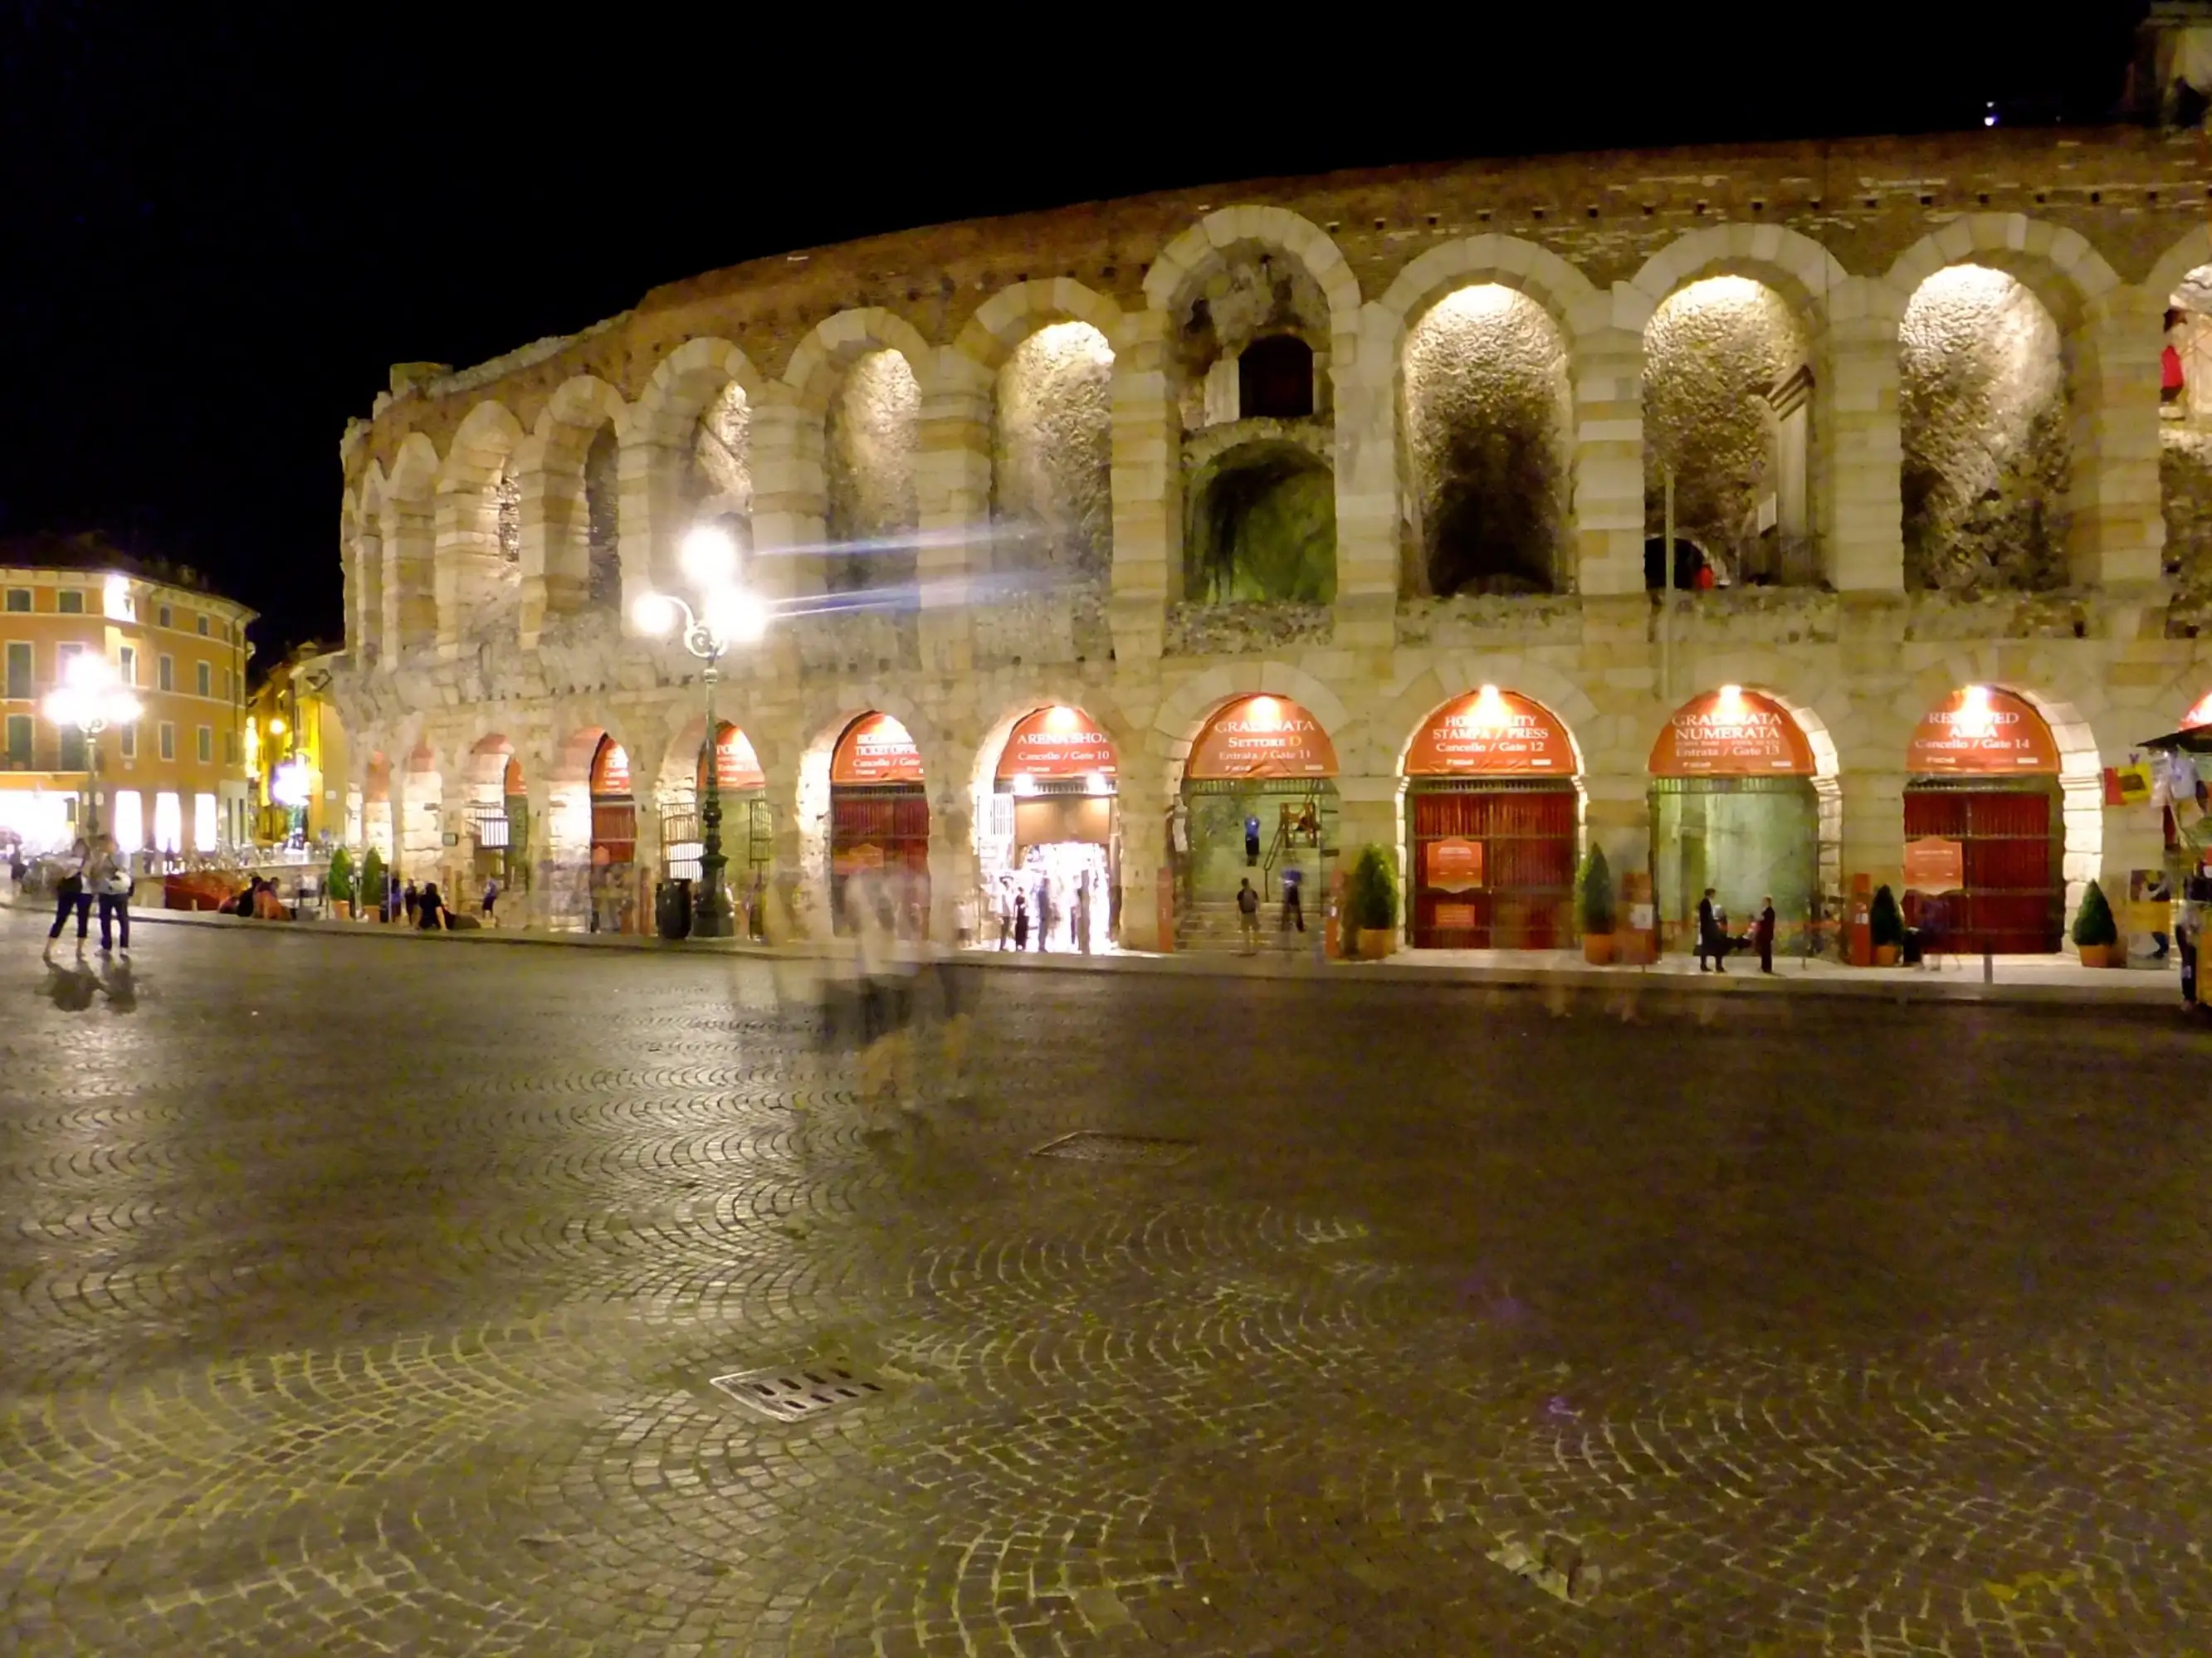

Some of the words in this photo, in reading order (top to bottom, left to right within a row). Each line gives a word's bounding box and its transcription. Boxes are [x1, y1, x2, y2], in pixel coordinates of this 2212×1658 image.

[1445, 715, 1537, 728] HOLITY
[1929, 712, 2020, 724] REVED
[1433, 728, 1491, 740] STAMPA
[1507, 728, 1549, 739] PRESS
[1675, 726, 1780, 739] NUMERATA
[1948, 724, 1999, 738] AA
[1017, 733, 1069, 745] ARENA
[1228, 737, 1287, 748] SETTORE
[1289, 736, 1302, 746] D
[1915, 739, 1968, 749] Cancello
[1981, 739, 2011, 749] Gate
[2014, 739, 2030, 749] 14
[1435, 742, 1487, 752] Cancello
[1498, 742, 1527, 752] Gate
[1530, 742, 1545, 752] 12
[1676, 747, 1719, 757] Entrata
[1732, 746, 1761, 756] Gate
[1765, 745, 1780, 755] 13
[1018, 751, 1062, 761] Cancello
[1070, 751, 1096, 760] Gate
[1096, 750, 1110, 760] 10
[1218, 752, 1258, 760] Entrata
[1270, 750, 1296, 759] Gate
